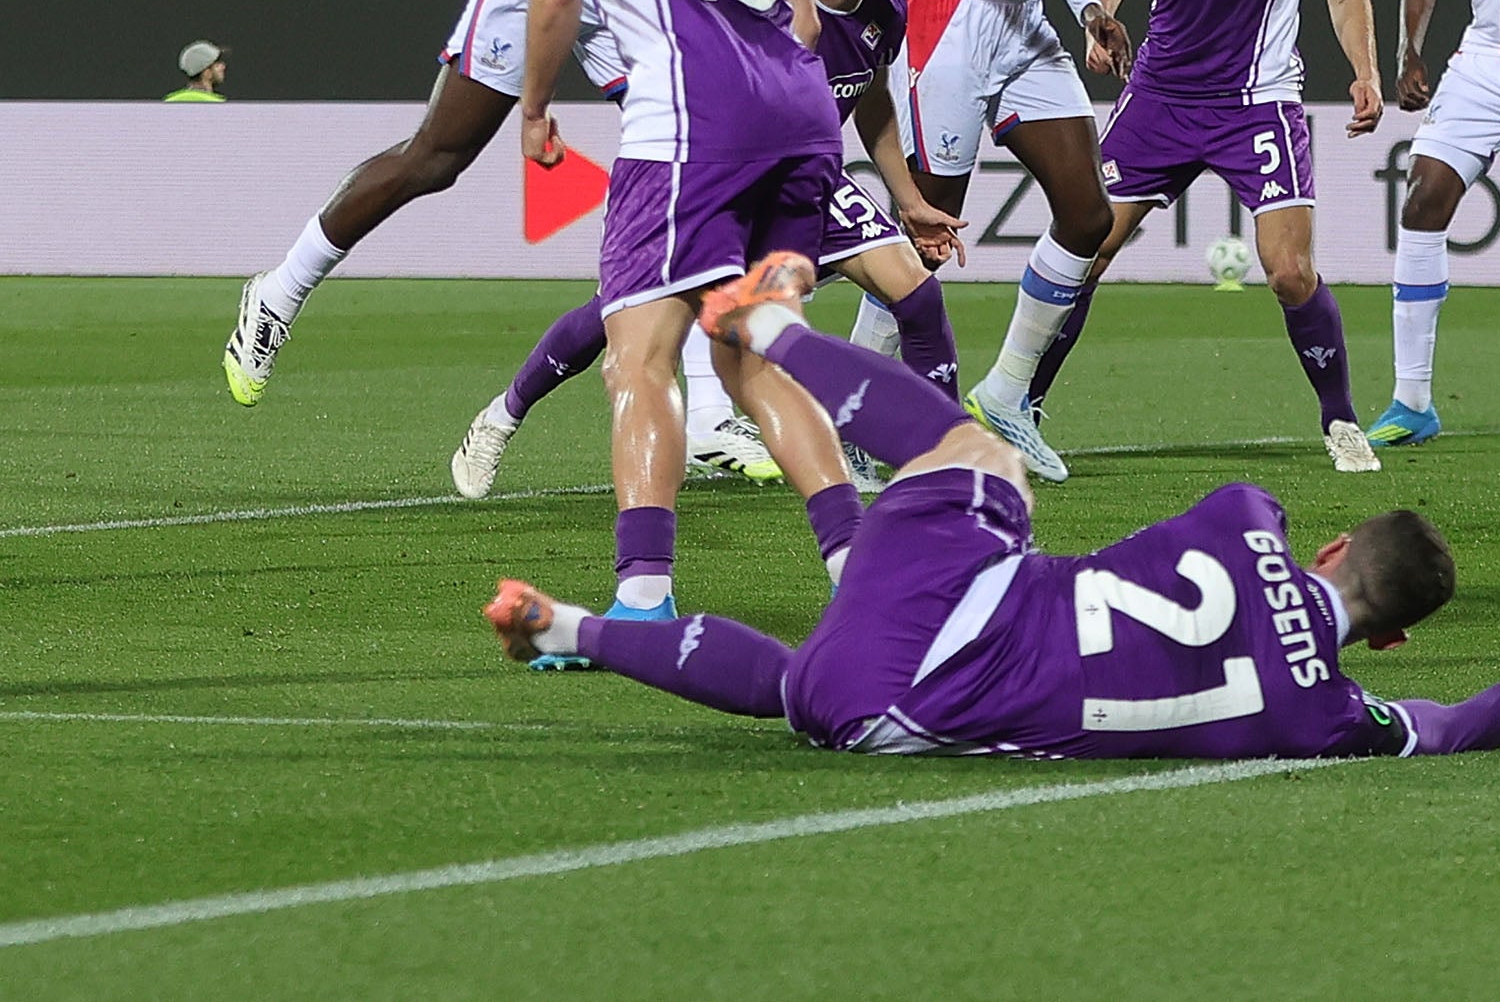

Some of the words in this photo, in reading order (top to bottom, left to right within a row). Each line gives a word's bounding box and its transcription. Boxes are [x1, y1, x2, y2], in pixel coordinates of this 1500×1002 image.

[1253, 130, 1281, 175] 5
[829, 185, 877, 229] 15
[1074, 549, 1266, 731] 21
[1242, 529, 1330, 689] GOSENS
